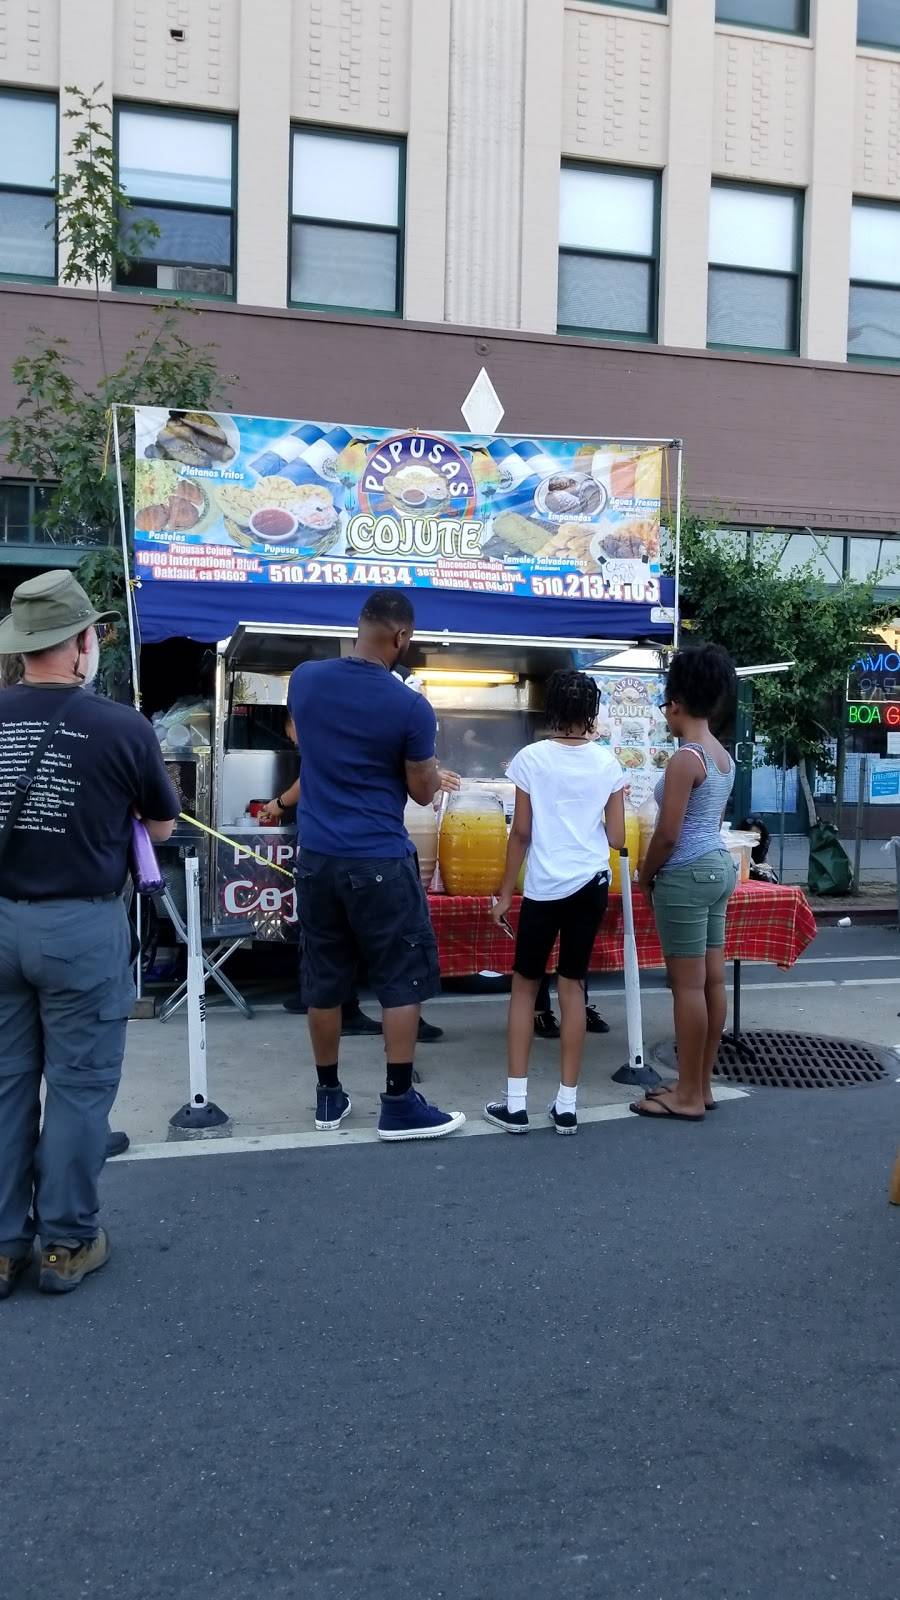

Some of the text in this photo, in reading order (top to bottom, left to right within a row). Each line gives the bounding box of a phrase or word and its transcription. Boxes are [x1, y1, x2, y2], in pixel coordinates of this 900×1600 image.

[220, 469, 245, 480] Fritos
[365, 438, 469, 497] PUPUSAS
[548, 511, 593, 523] Empanadas
[148, 530, 187, 541] Pasteles
[348, 514, 483, 558] COJUTE
[170, 543, 233, 556] Pupusas Cojute
[264, 544, 300, 555] Pupusas
[169, 554, 234, 569] International
[503, 554, 535, 565] Tamales
[269, 562, 412, 585] 510.213.4434
[441, 569, 501, 582] International
[614, 679, 647, 698] PUPUSAS
[609, 703, 652, 718] COJUTE
[849, 705, 882, 724] BOA
[234, 844, 301, 866] PUP
